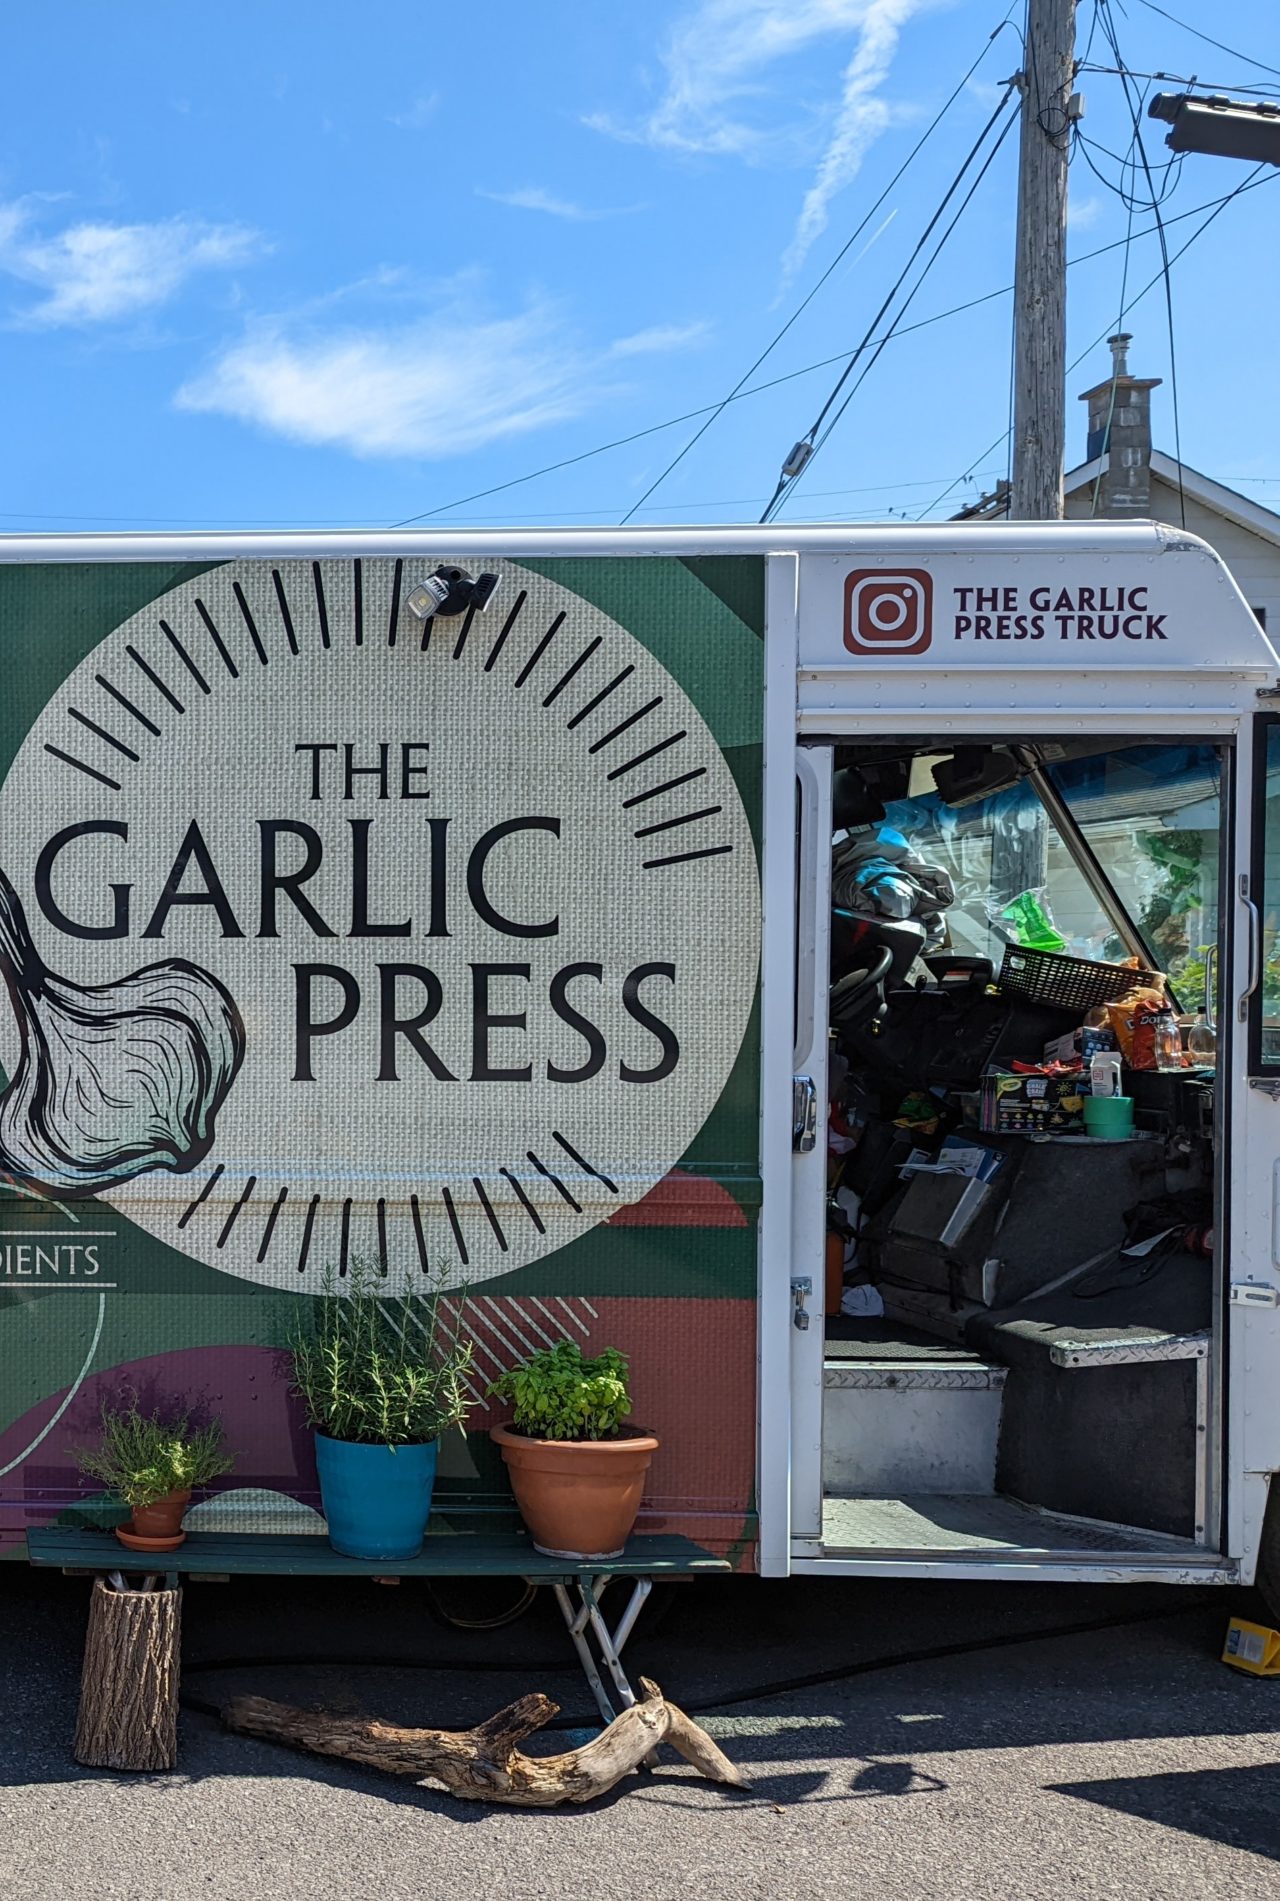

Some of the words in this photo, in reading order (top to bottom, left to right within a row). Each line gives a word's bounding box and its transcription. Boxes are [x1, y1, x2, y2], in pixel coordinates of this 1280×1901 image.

[953, 587, 1018, 612] THE
[1028, 586, 1149, 612] GARLIC
[954, 615, 1045, 640] PRESS
[1054, 615, 1169, 640] TRUCK
[294, 742, 431, 801] THE
[34, 816, 562, 940] GARLIC
[289, 962, 681, 1085] PRESS
